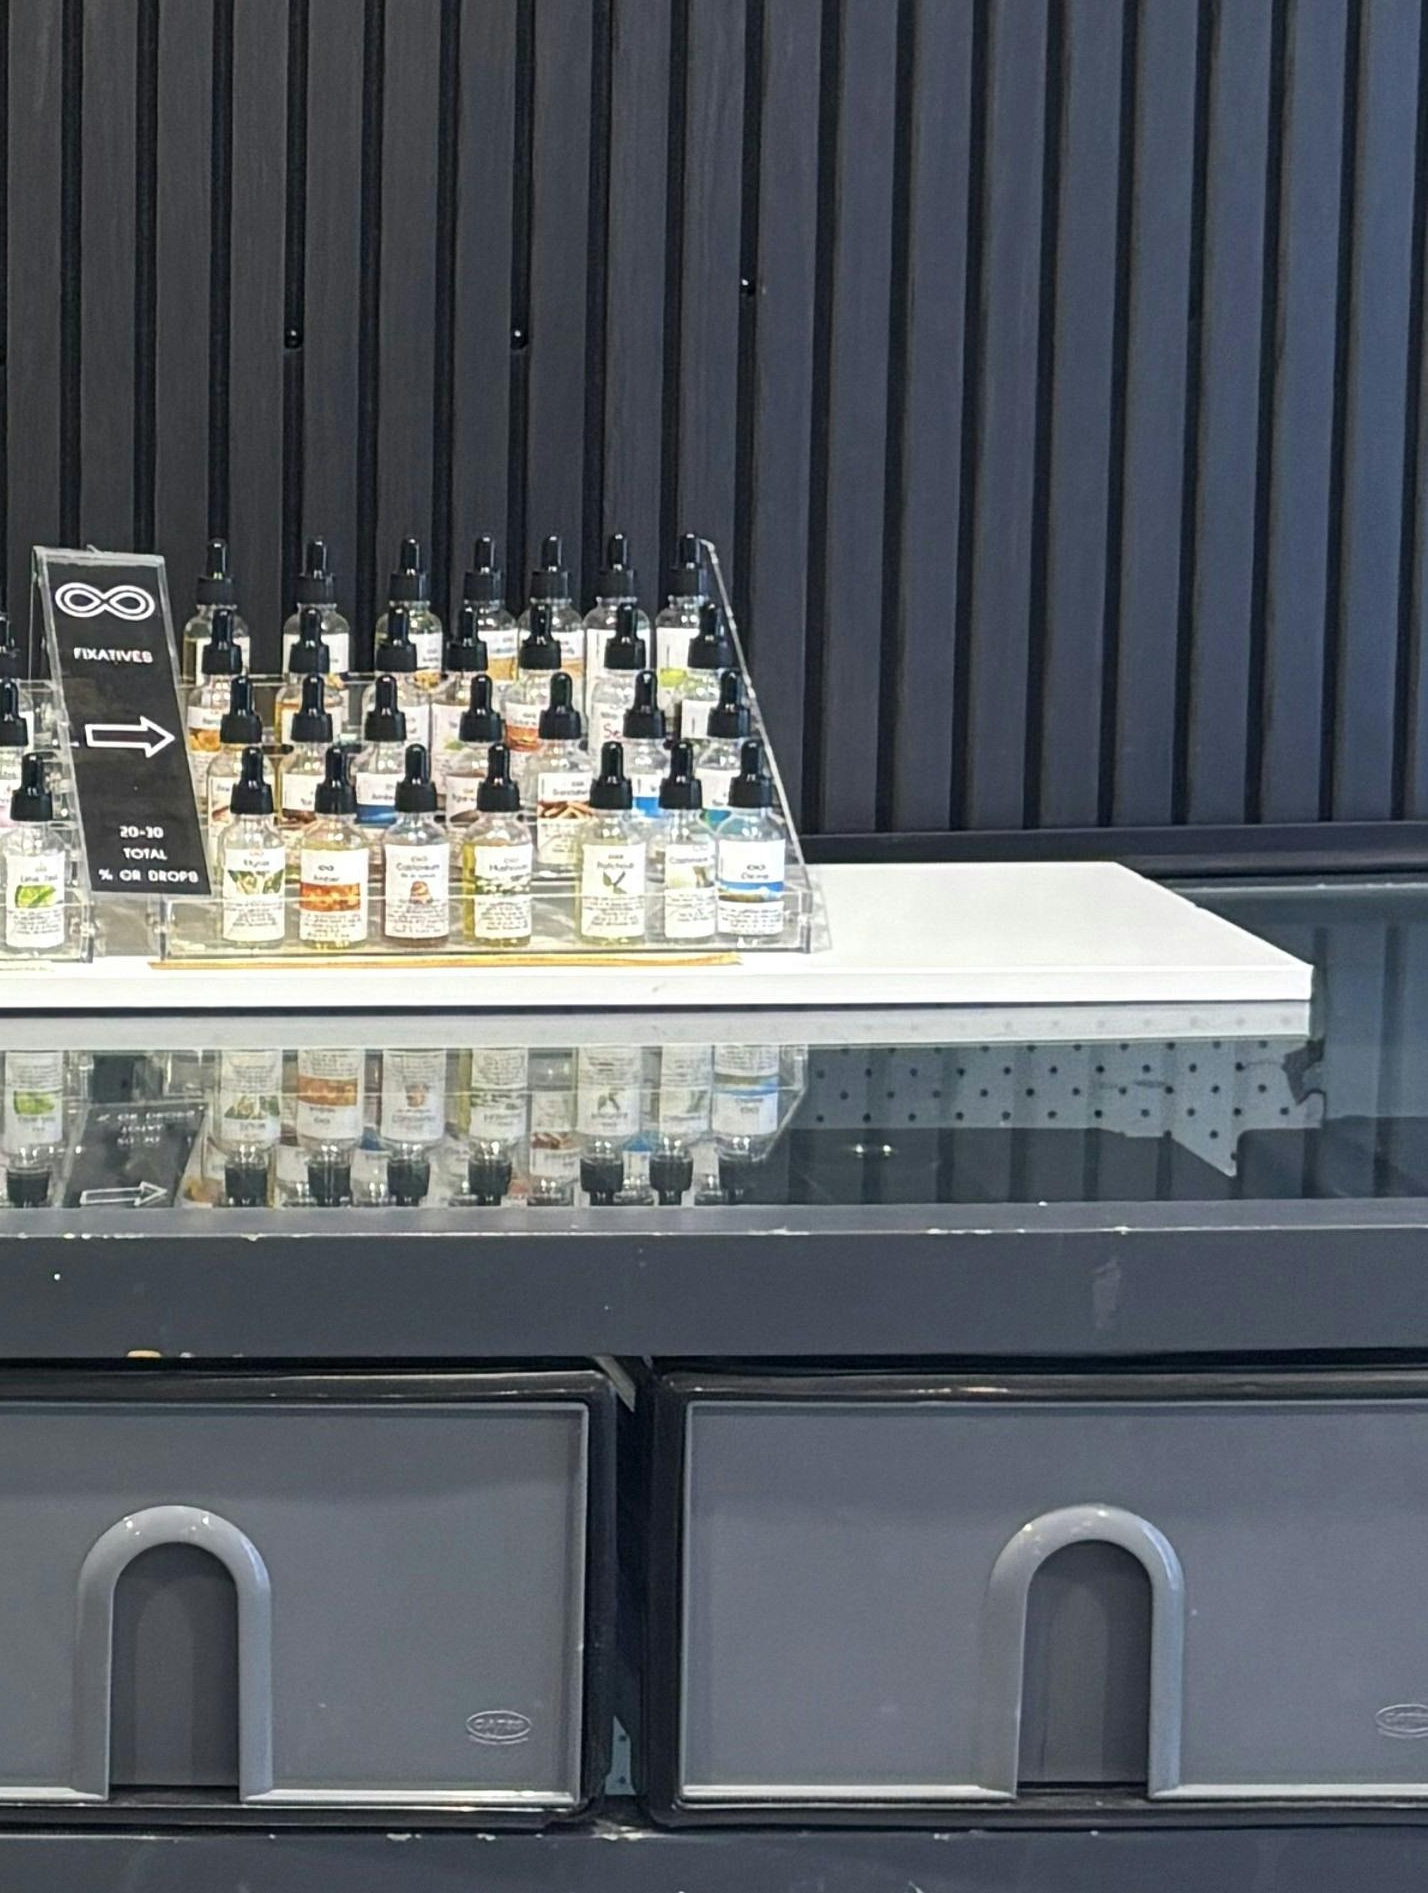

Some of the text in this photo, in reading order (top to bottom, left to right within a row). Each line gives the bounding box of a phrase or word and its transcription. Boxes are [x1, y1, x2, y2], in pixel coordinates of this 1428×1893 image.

[73, 647, 153, 664] FIXATIVES
[119, 825, 164, 839] 20-30
[123, 847, 168, 861] TOTAL
[119, 869, 142, 882] OR
[147, 870, 200, 884] DROPS
